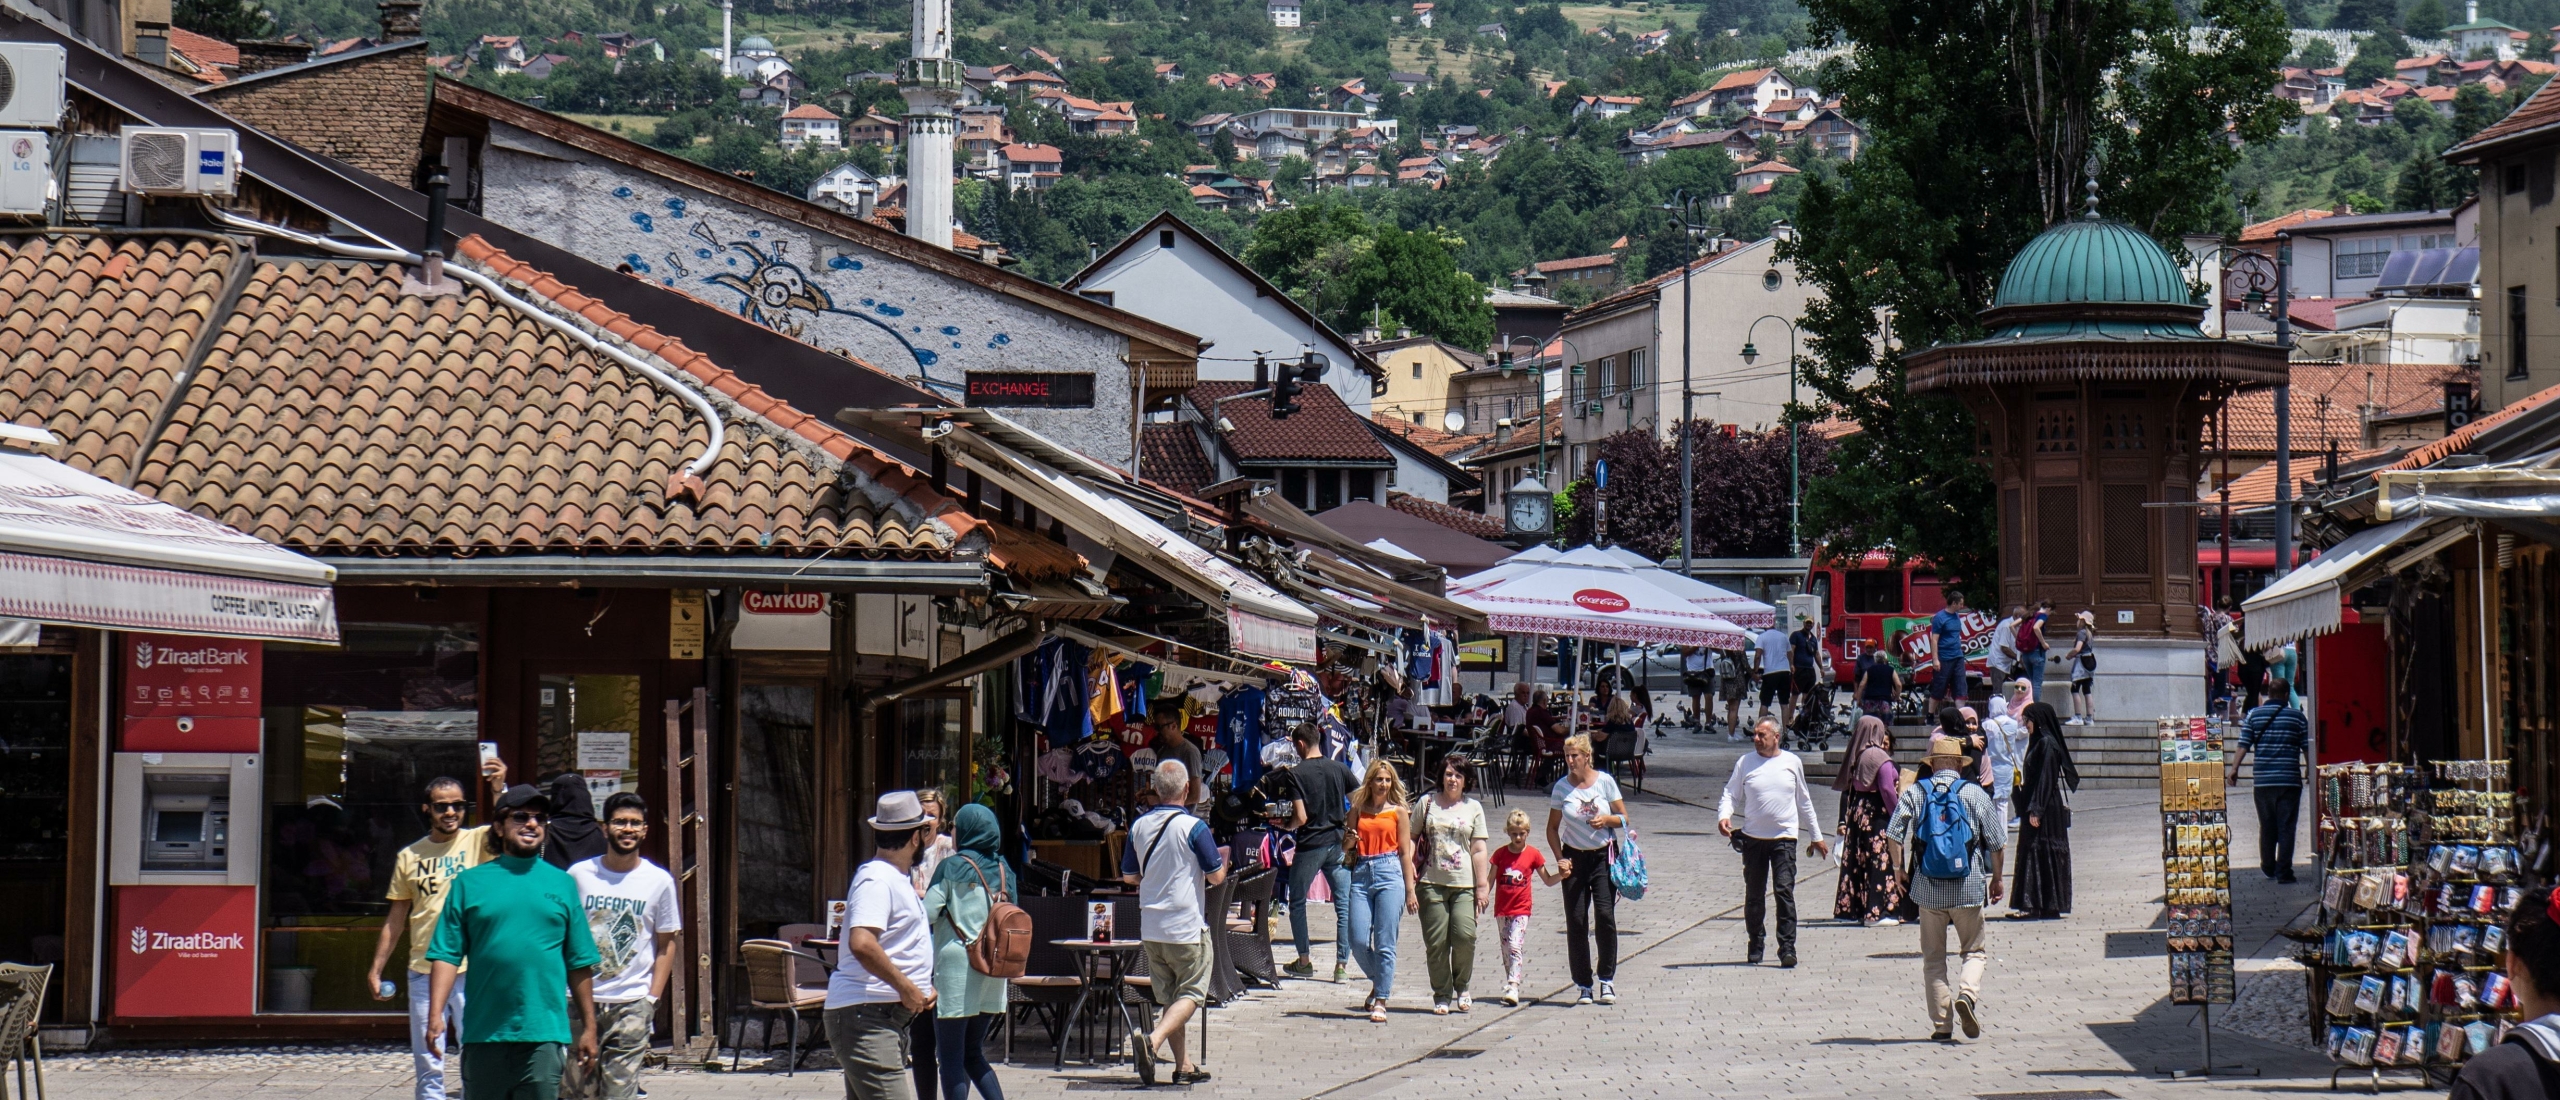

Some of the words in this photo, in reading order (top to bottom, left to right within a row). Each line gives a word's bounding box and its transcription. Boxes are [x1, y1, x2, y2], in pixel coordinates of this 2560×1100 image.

[13, 161, 31, 171] LG
[200, 157, 225, 168] Haier
[970, 381, 1051, 396] EXCHANGE
[211, 593, 246, 616] COFFEE
[248, 598, 267, 617] AND
[268, 601, 288, 619] TEA
[286, 602, 320, 620] KAFFA
[749, 592, 820, 611] ÇAYKUR
[1576, 595, 1625, 607] Coca-Cola
[156, 647, 249, 665] ZiraatBank
[1278, 706, 1310, 719] RONALDO
[1194, 723, 1217, 734] M.SAL
[1121, 729, 1144, 746] 10
[1200, 735, 1217, 751] 11
[1330, 738, 1344, 761] 7
[151, 932, 245, 950] ZiraatBank
